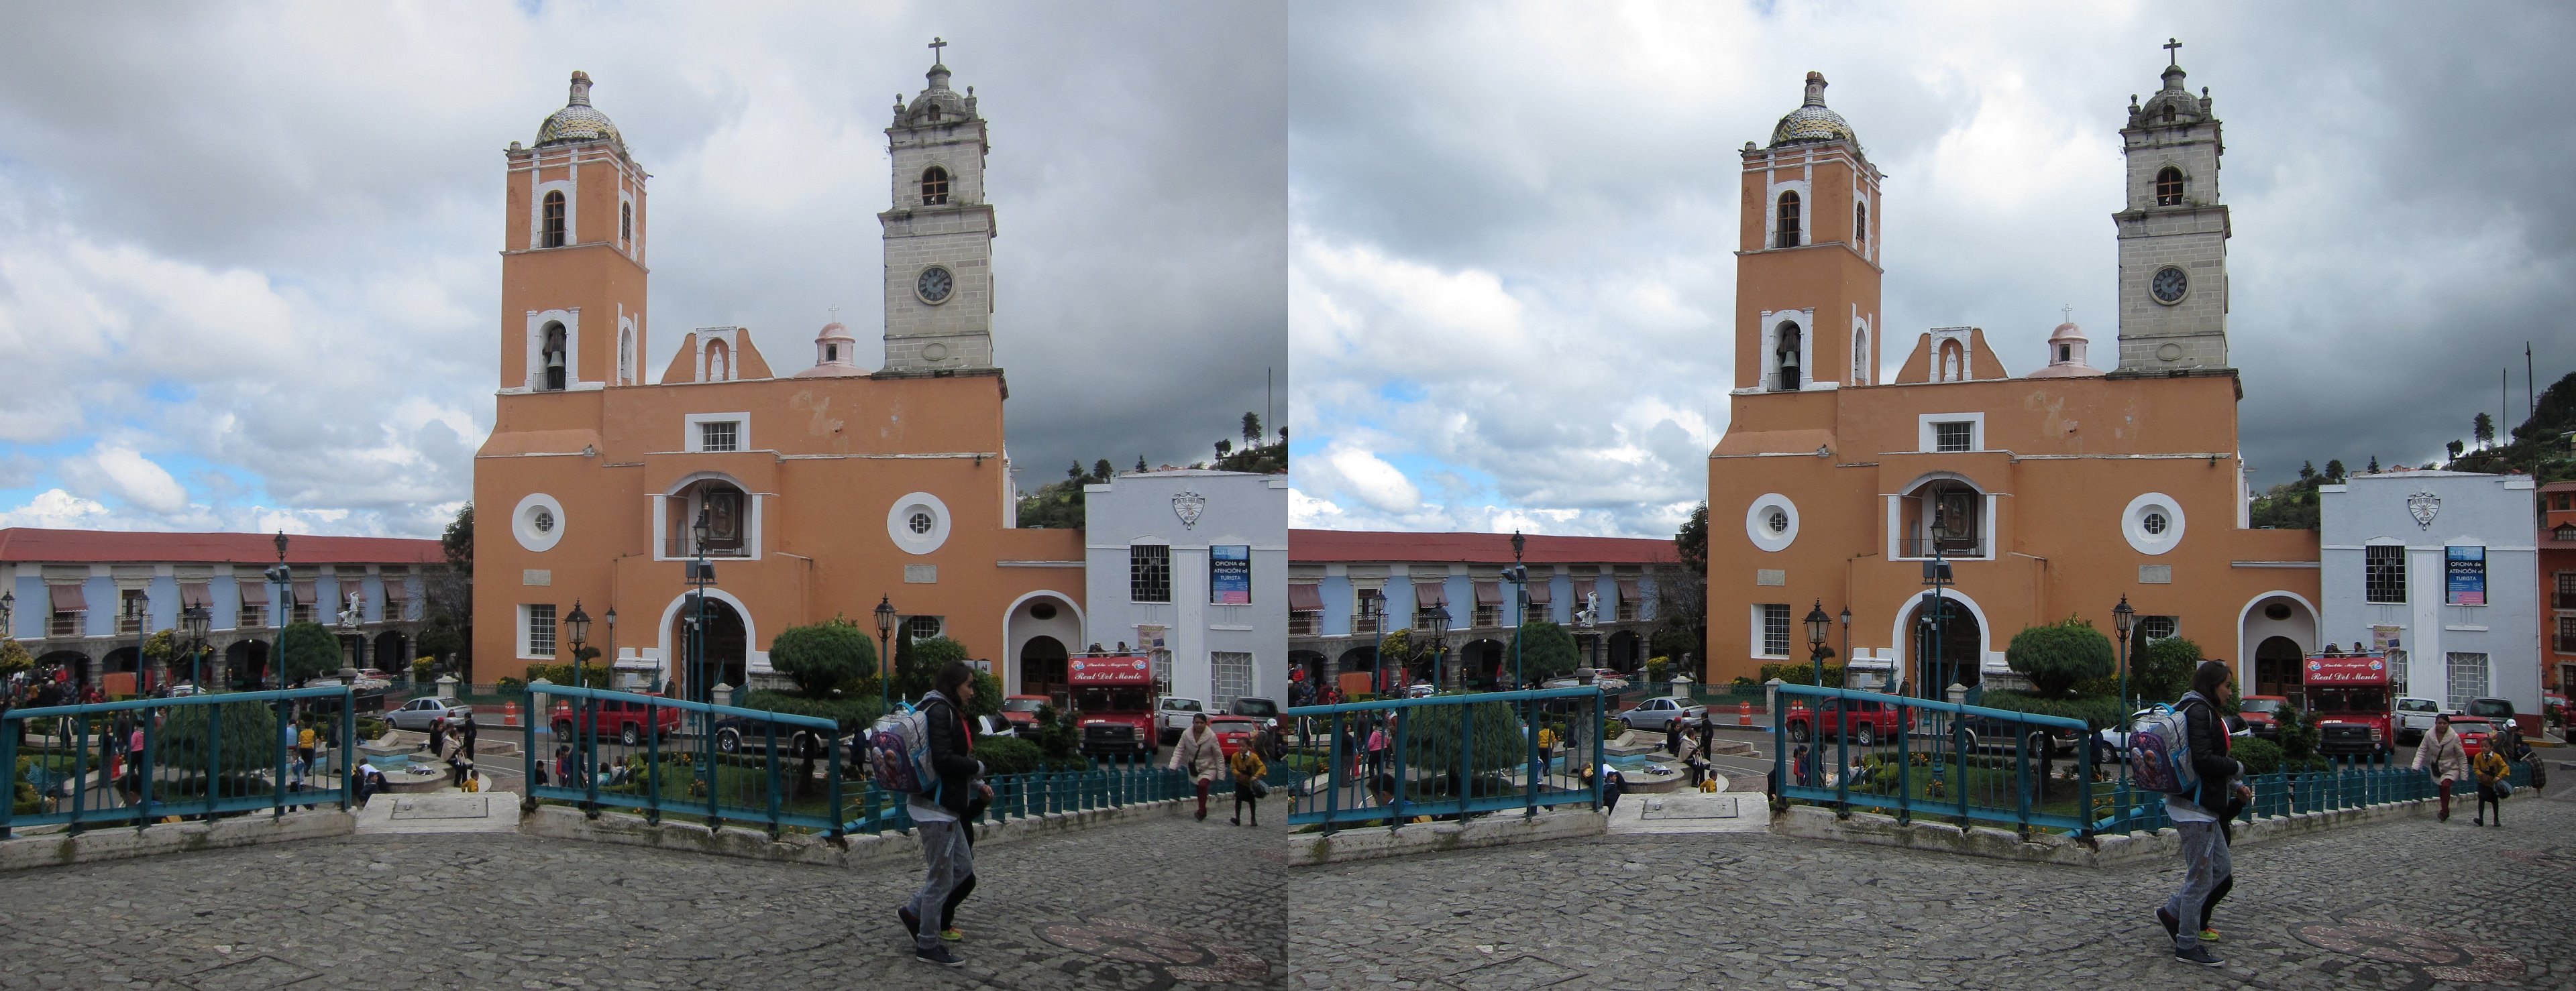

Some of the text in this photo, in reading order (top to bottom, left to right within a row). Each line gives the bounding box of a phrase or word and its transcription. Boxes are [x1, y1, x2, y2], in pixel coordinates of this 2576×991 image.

[1074, 672, 1142, 680] Real Del Monte
[2311, 673, 2333, 681] Real
[2334, 672, 2350, 681] Del
